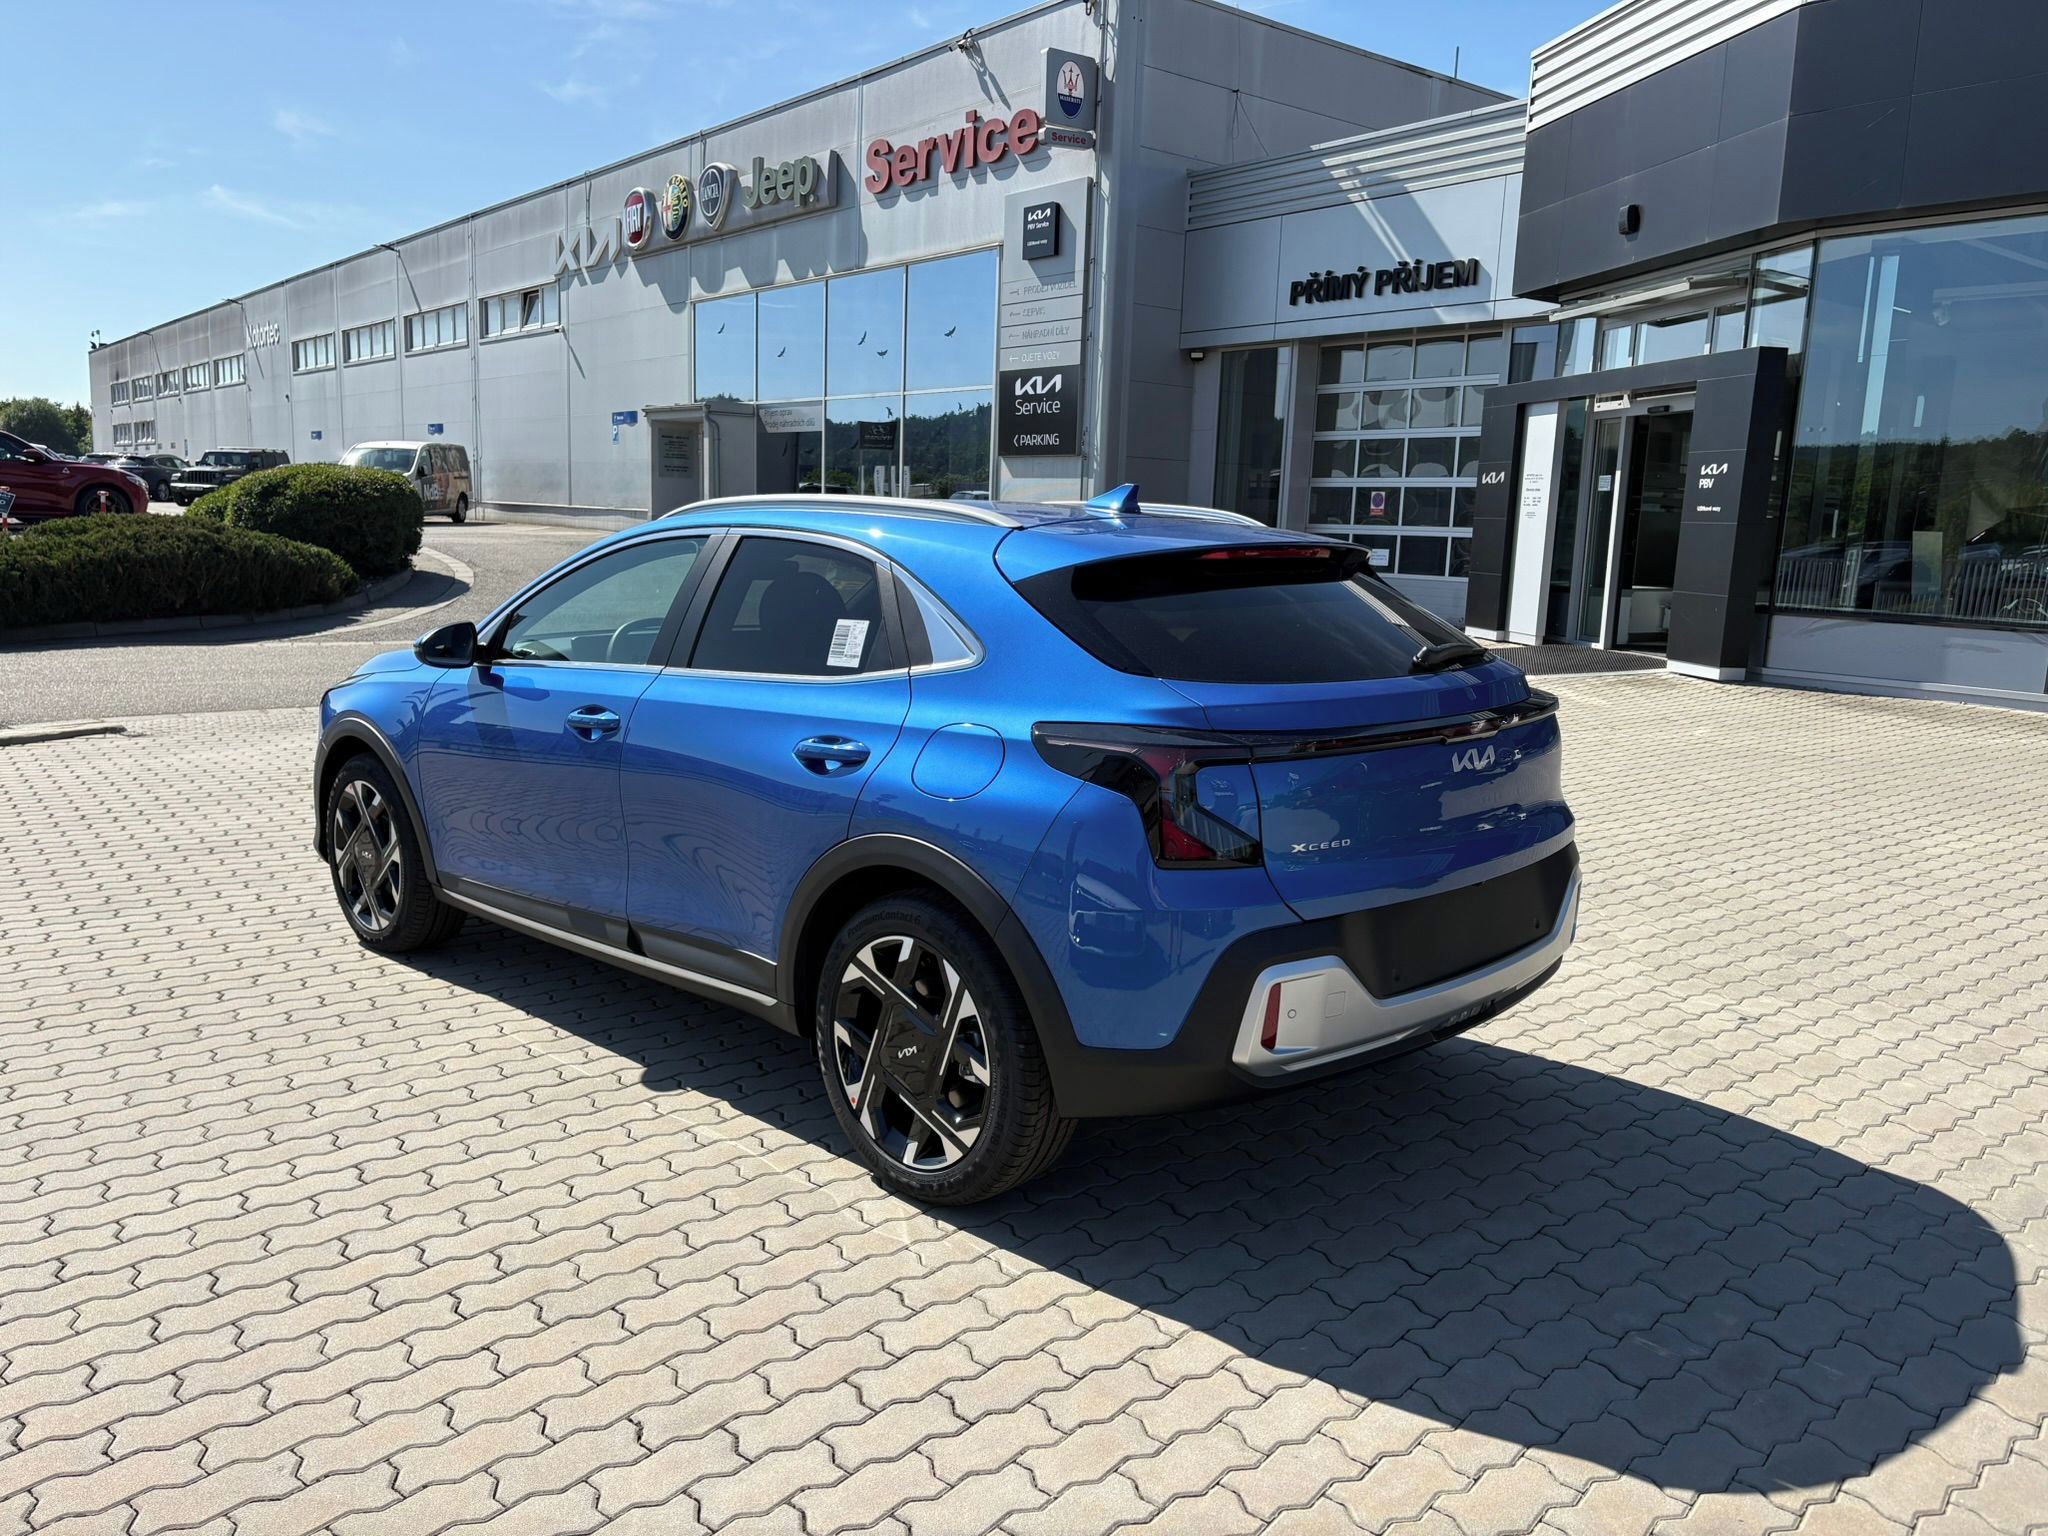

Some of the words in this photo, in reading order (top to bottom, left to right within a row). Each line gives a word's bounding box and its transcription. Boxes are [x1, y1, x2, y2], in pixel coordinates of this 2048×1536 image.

[1051, 131, 1087, 144] Service
[864, 108, 1040, 194] Service
[744, 155, 818, 208] Jeep
[625, 202, 643, 233] FIAT
[1027, 207, 1051, 222] KIA
[1289, 265, 1372, 306] PŘÍMÝ
[1374, 258, 1480, 297] PŘÍJEM
[1015, 373, 1063, 396] KIA
[1015, 397, 1061, 416] Service
[1020, 433, 1060, 447] PARKING
[1481, 471, 1505, 484] KIA
[1701, 462, 1729, 476] KIA
[1698, 478, 1715, 489] PBV
[1452, 745, 1496, 773] KIA
[1290, 838, 1351, 853] XCEED
